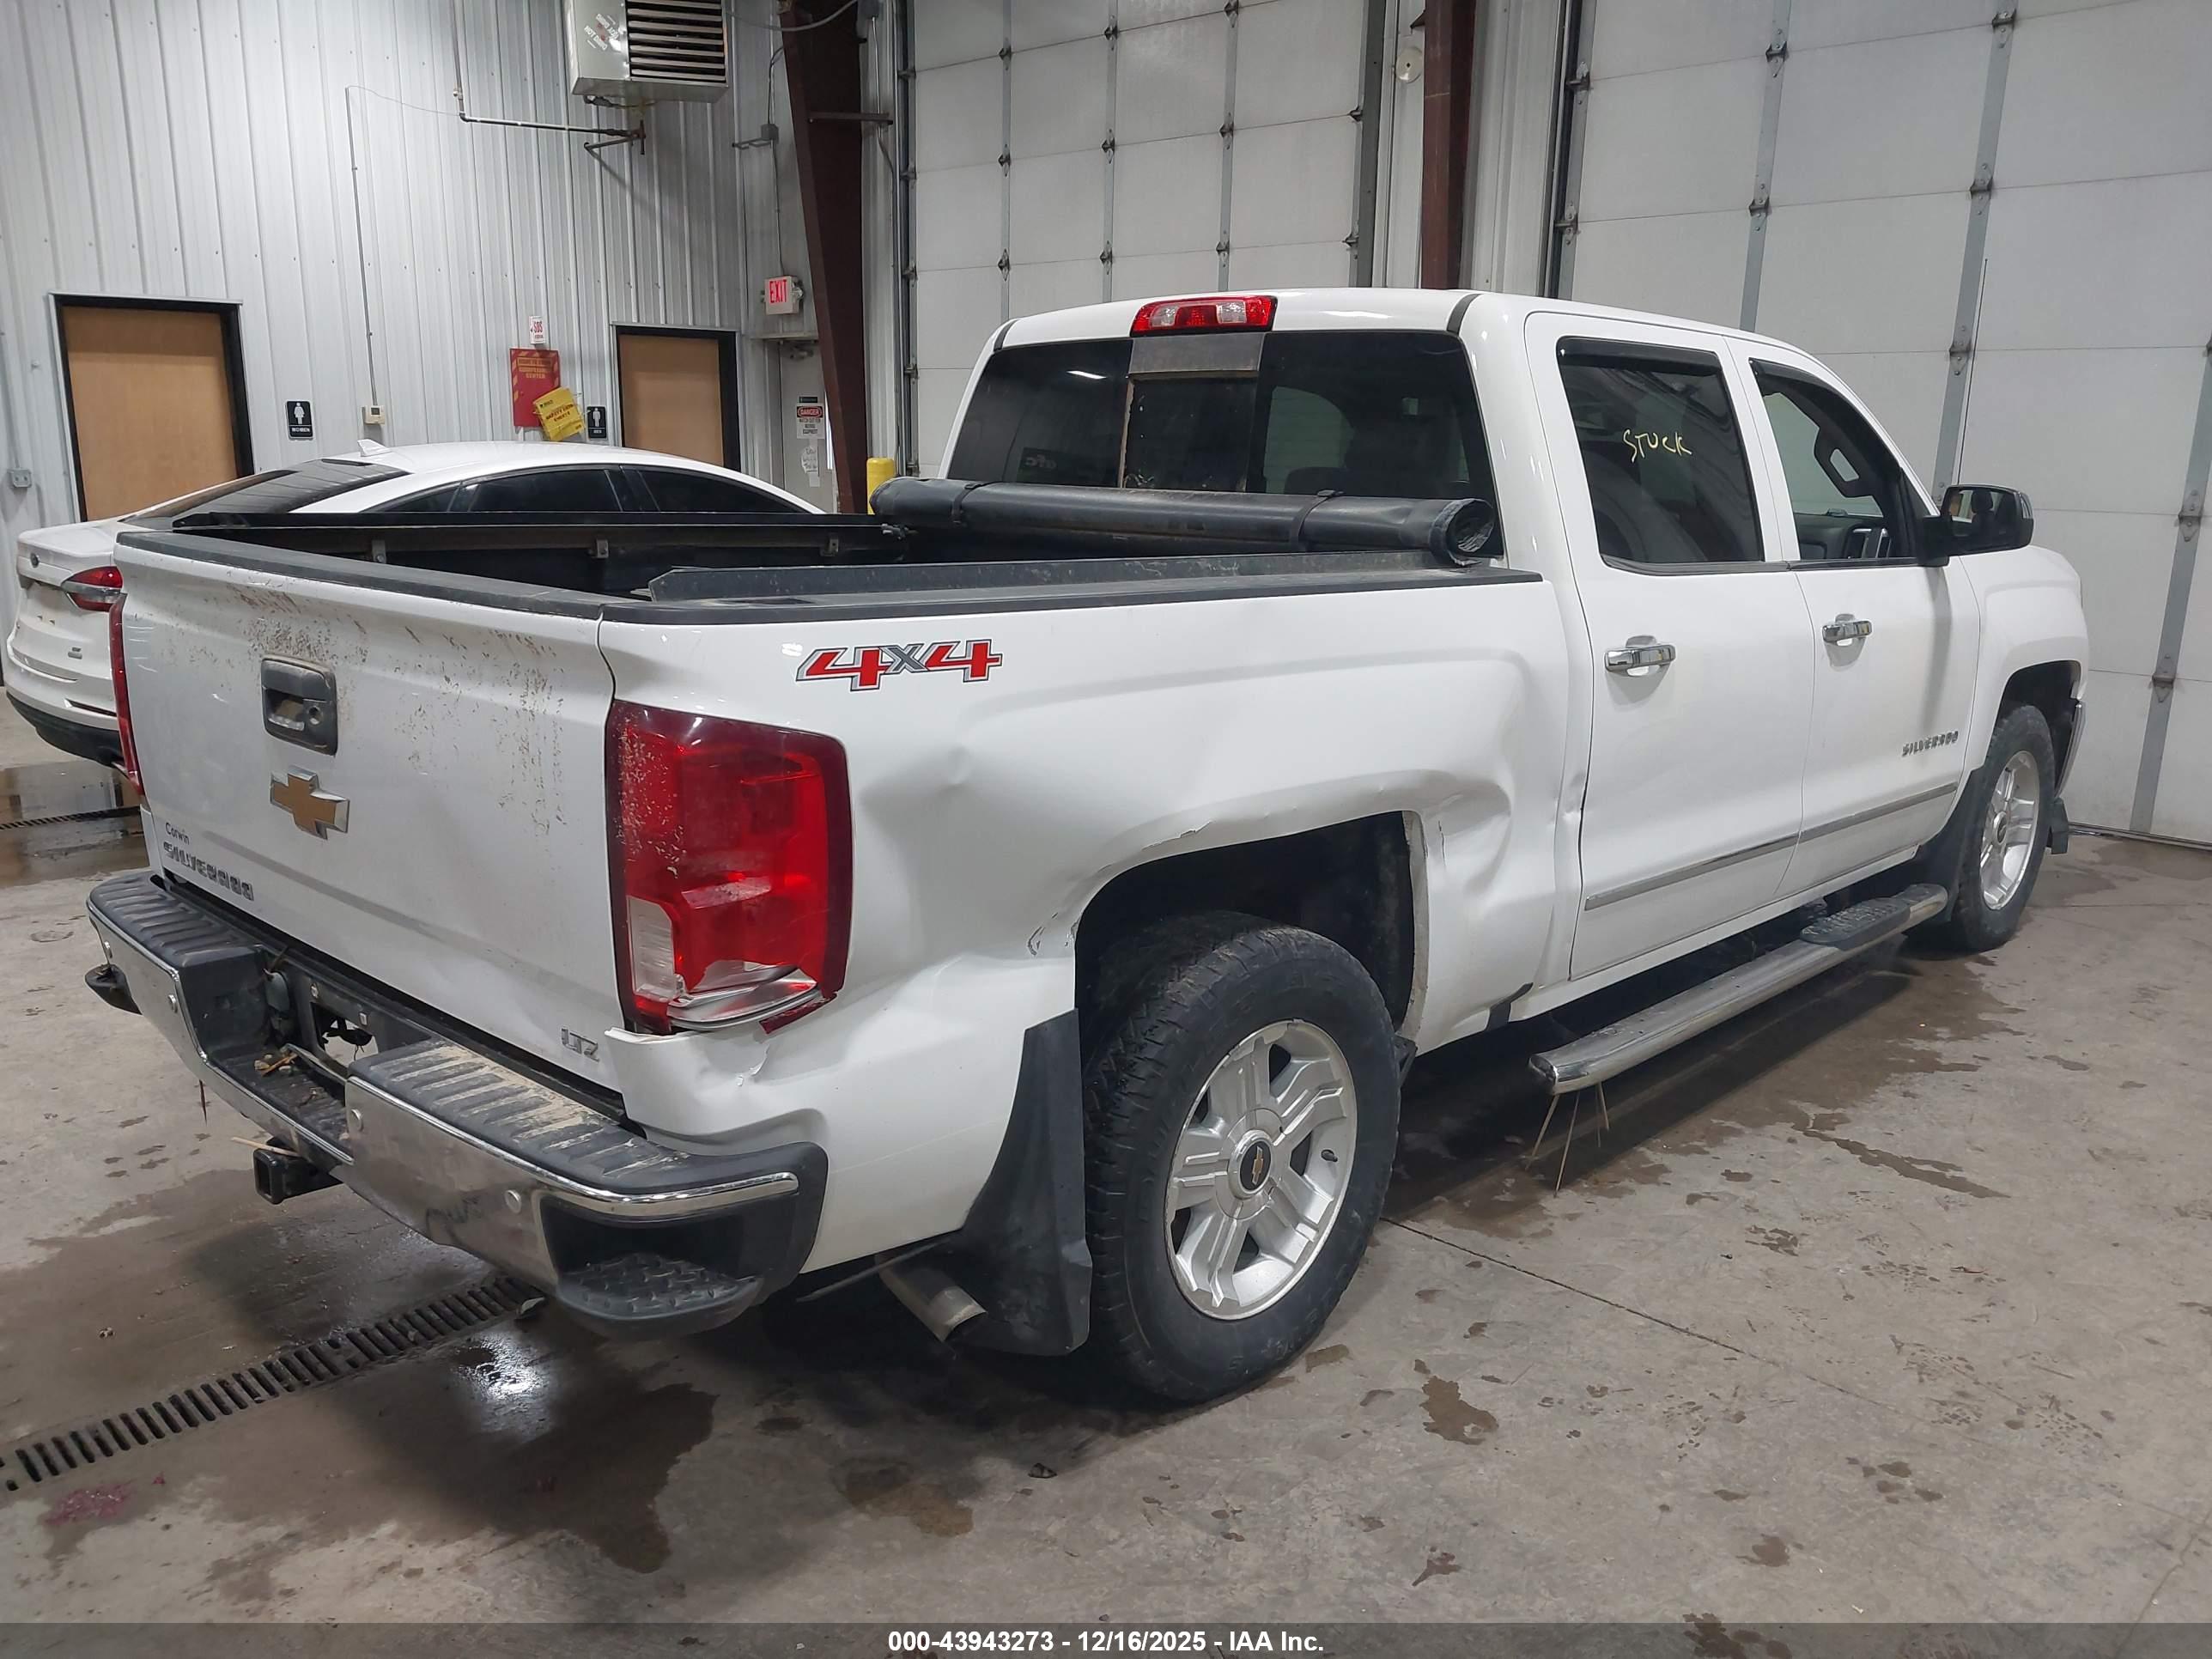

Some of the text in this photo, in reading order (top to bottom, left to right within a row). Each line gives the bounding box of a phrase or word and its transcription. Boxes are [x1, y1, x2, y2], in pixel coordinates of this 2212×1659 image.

[769, 278, 787, 304] EXIT
[1623, 428, 1692, 464] STUCK
[1901, 730, 1959, 757] SILVERADO
[165, 822, 190, 845] Corwin
[163, 842, 254, 901] SILVERADO
[561, 1028, 600, 1062] LTZ
